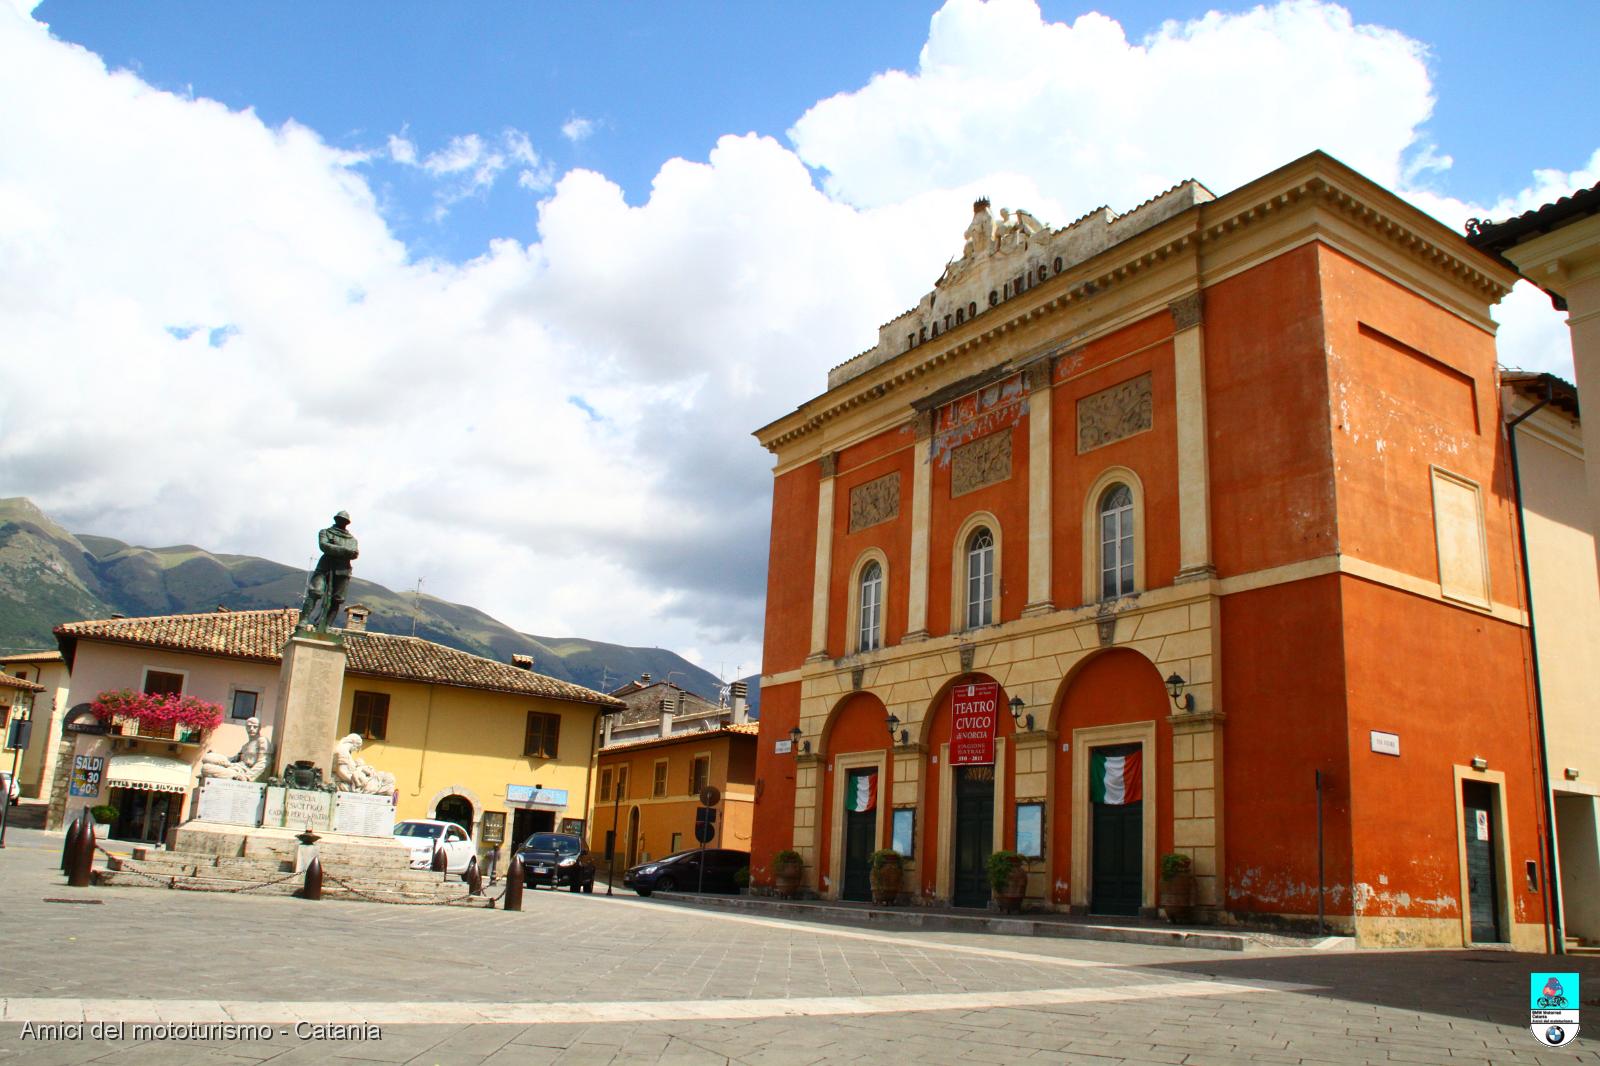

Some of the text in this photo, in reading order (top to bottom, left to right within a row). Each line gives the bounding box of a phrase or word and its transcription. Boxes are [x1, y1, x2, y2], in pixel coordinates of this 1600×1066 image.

[907, 256, 1063, 350] TEATRO CIVICO
[954, 699, 995, 715] TEATRO
[956, 716, 991, 730] CIVICO
[961, 731, 987, 739] NORCIA
[75, 756, 103, 771] SALDI
[87, 771, 99, 784] 30
